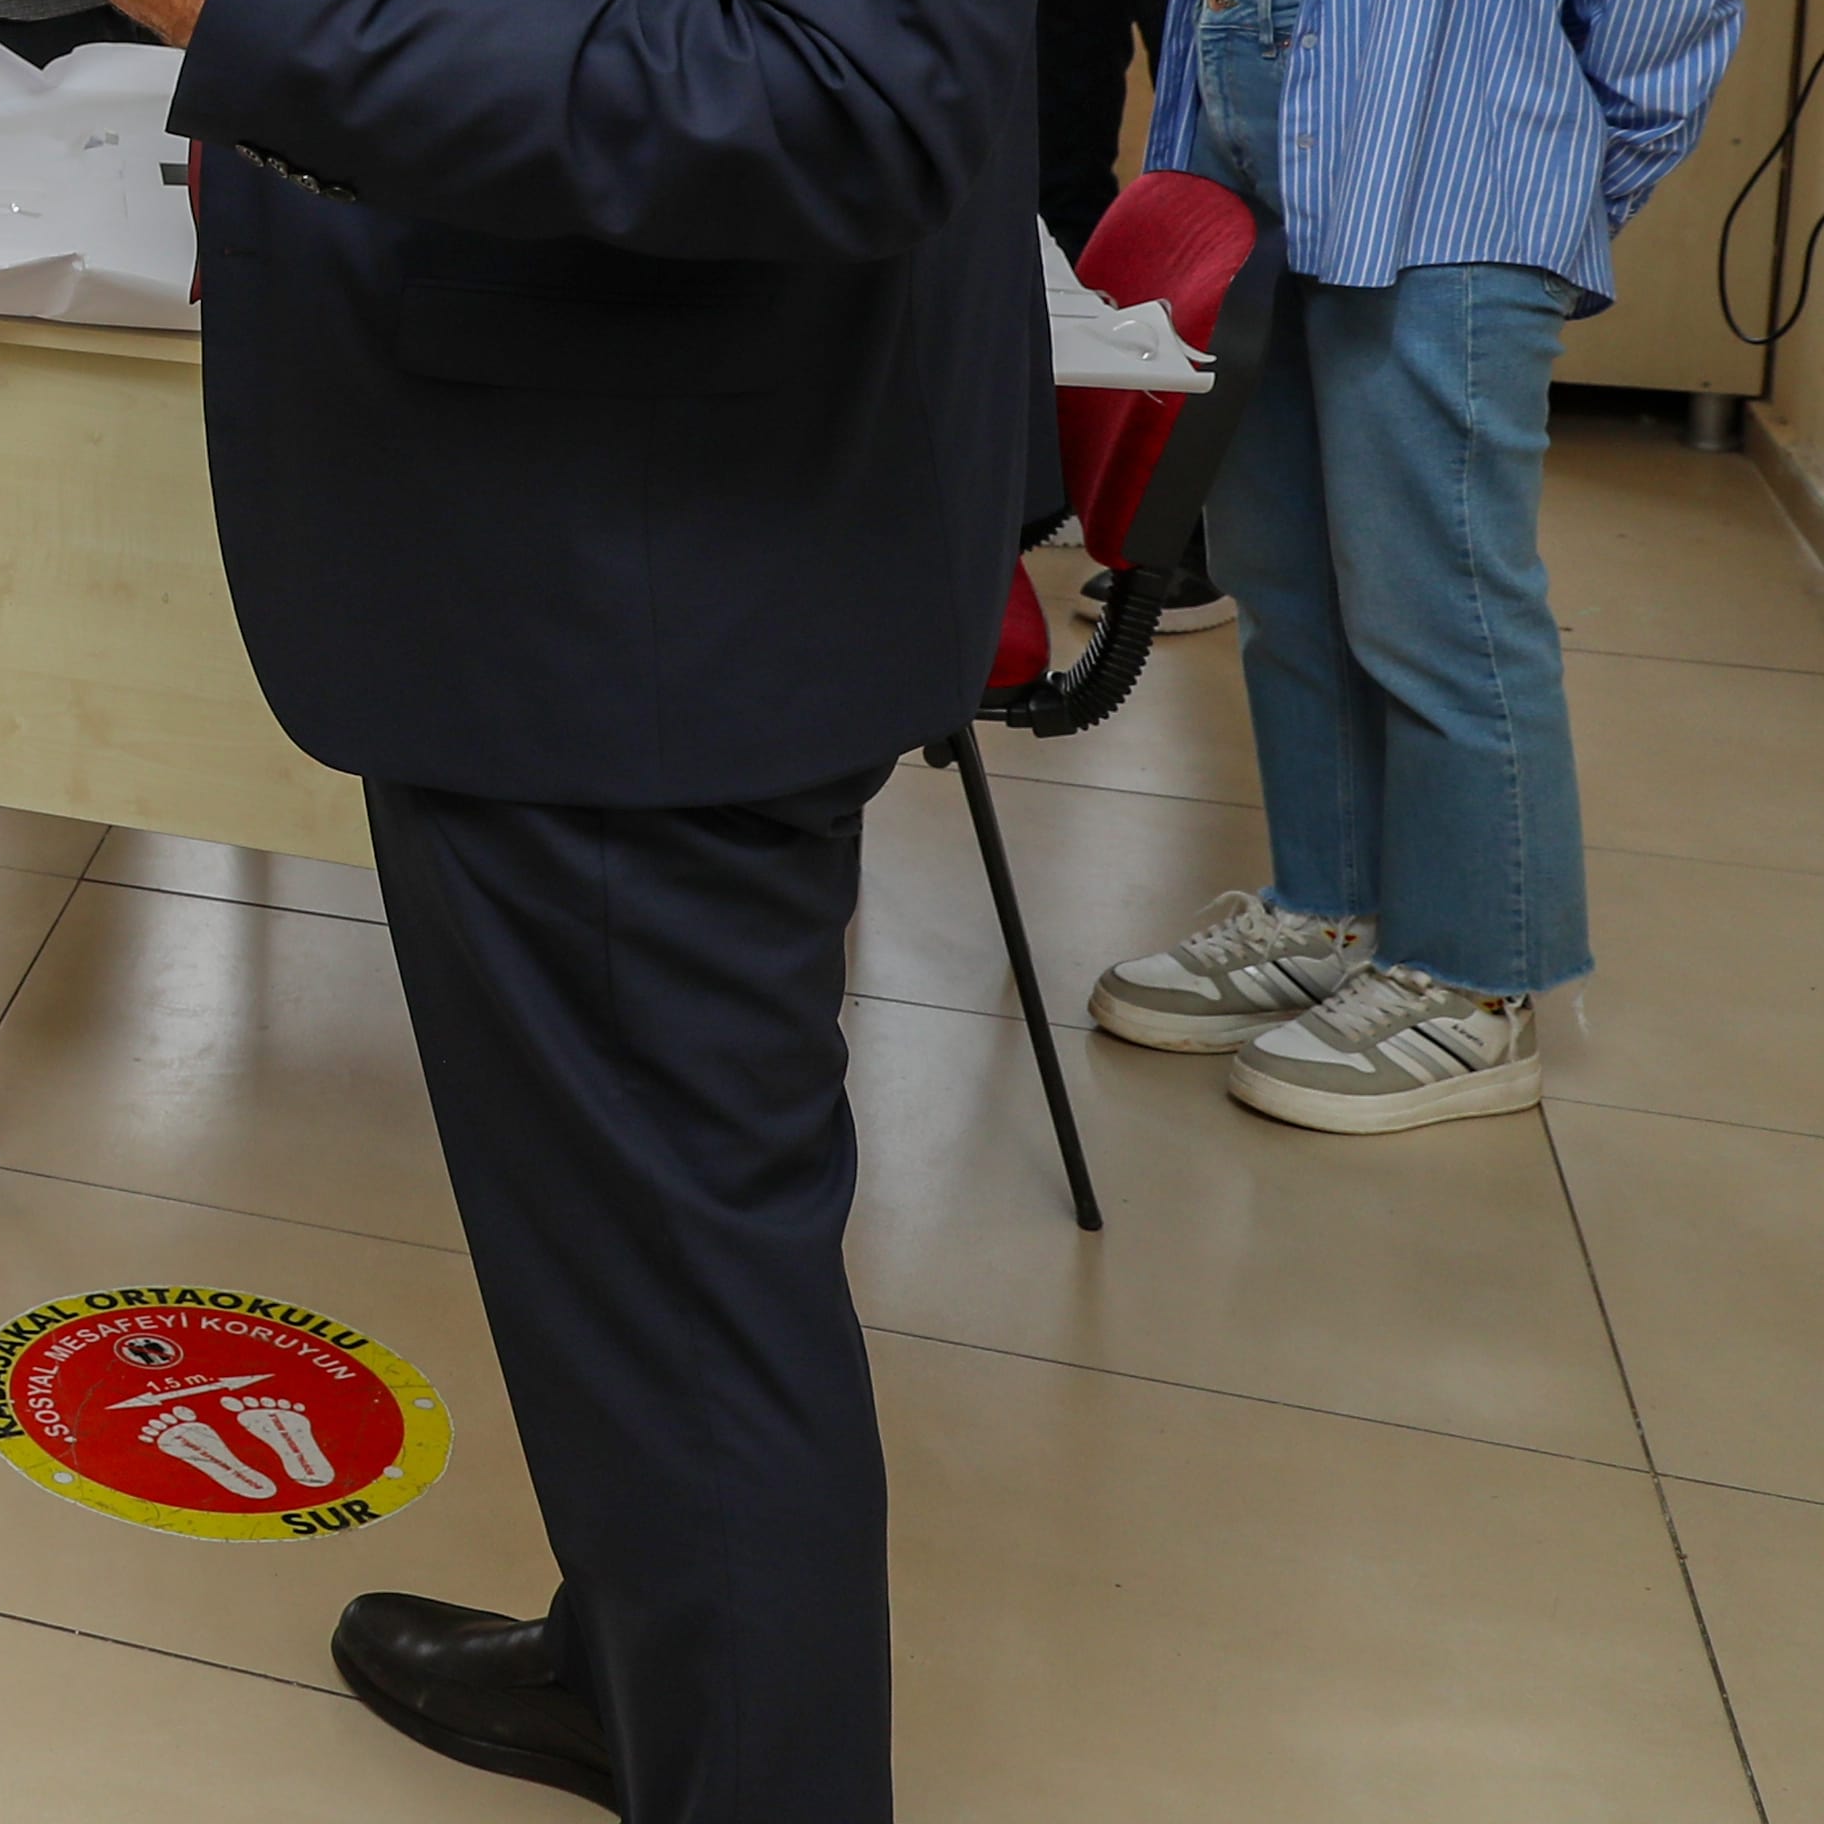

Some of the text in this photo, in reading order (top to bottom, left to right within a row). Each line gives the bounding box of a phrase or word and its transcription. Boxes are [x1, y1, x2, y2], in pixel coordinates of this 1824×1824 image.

[84, 1287, 370, 1351] ORTAOKULU
[26, 1311, 358, 1438] SOSYAL MESAFEYİ KORUYUN
[146, 1373, 215, 1393] 1.5 m.
[280, 1499, 383, 1535] SUR
